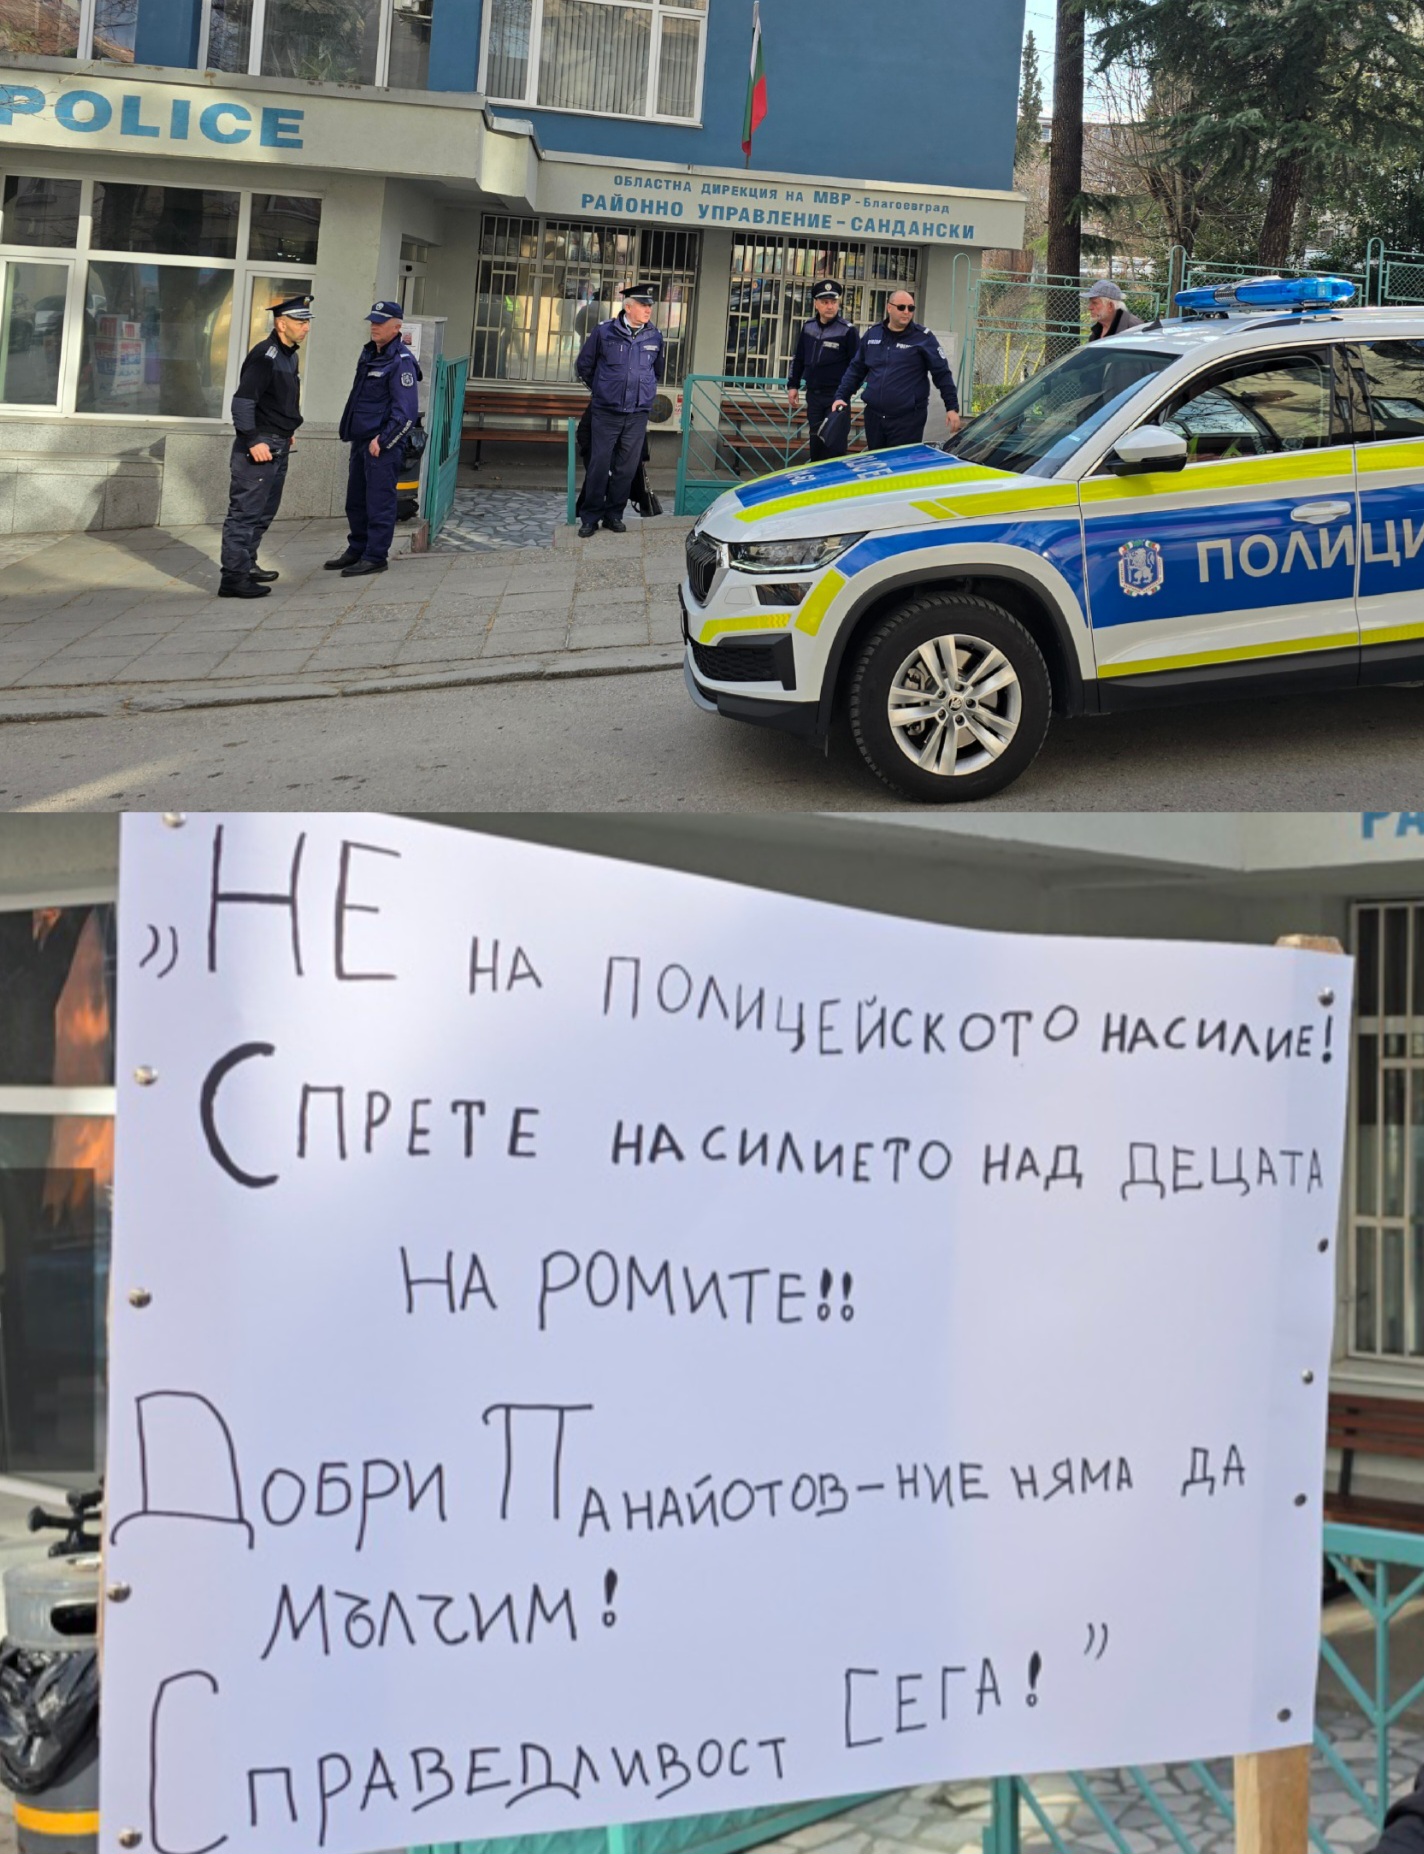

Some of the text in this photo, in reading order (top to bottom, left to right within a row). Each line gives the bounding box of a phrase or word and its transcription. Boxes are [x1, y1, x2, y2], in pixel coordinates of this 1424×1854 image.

[0, 84, 304, 149] POLICE
[581, 193, 684, 217] РАЙОННО
[614, 175, 692, 192] ОБЛАСТНА
[700, 183, 778, 200] ДИРЕКЦИЯ
[786, 191, 803, 202] НА
[469, 936, 543, 995] НА
[603, 956, 1079, 1057] ПОЛИЦЕЙСКОТО
[1101, 1012, 1333, 1063] НАСИЛИЕ!
[200, 1041, 1322, 1201] СПРЕТЕ НАСИЛИЕТО НАД ДЕЦАТА
[400, 1245, 855, 1332] НА РОМИТЕ!!
[110, 1390, 447, 1552] ДОБРИ
[1010, 1456, 1133, 1502] НЯМА
[1181, 1443, 1246, 1497] ДА
[260, 1568, 618, 1661] МЪЛЧИМ!
[150, 1669, 787, 1854] СПРАВЕДЛИВОСТ
